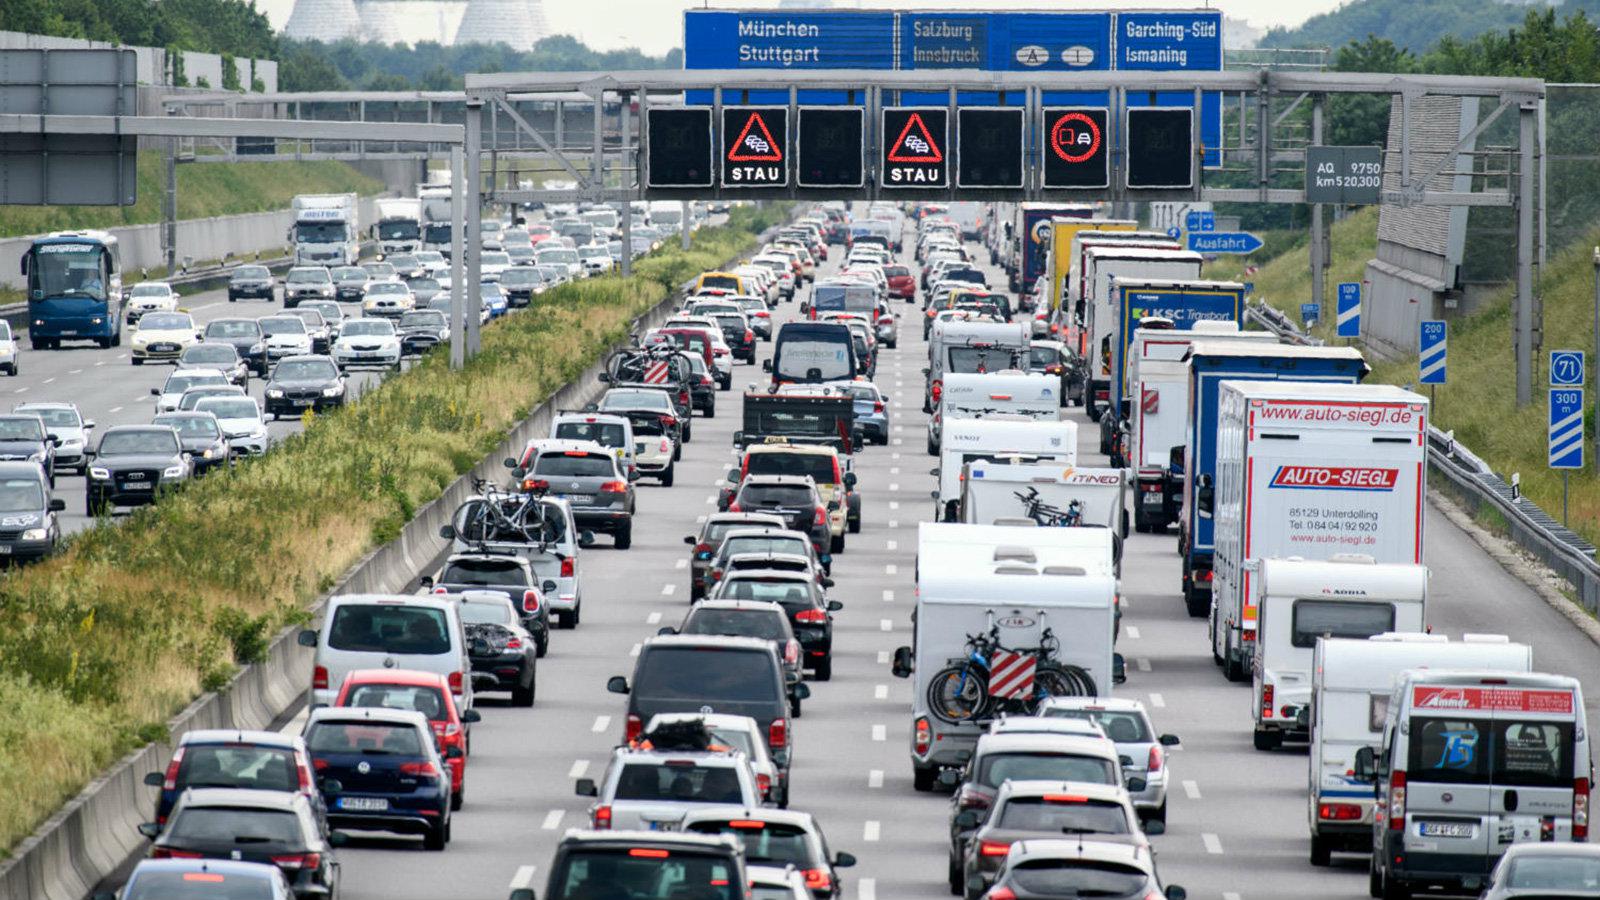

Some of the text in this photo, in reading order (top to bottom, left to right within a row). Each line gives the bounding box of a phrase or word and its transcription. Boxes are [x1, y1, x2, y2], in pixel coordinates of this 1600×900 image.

[738, 20, 819, 37] München
[914, 21, 973, 41] Salzburg
[1126, 21, 1216, 41] Garching-Süd
[739, 45, 820, 65] Stuttgart
[914, 46, 980, 62] Innsbruck
[1027, 49, 1038, 63] A
[1126, 46, 1187, 66] Ismaning
[732, 167, 779, 181] STAU
[891, 168, 938, 182] STAU
[1317, 162, 1335, 174] AQ
[1316, 176, 1335, 187] km
[1195, 237, 1246, 249] Ausfahrt
[1342, 285, 1356, 294] 100
[1153, 308, 1230, 321] KSC Transport
[1425, 324, 1441, 334] 200
[1559, 360, 1575, 377] 71
[1556, 393, 1577, 404] 300
[1261, 405, 1411, 426] www.auto-siegl.de
[1282, 468, 1391, 485] AUTO-SIEGL
[1289, 508, 1378, 521] 85129 Unterdolling
[1290, 534, 1377, 546] www.auto-siegl.de
